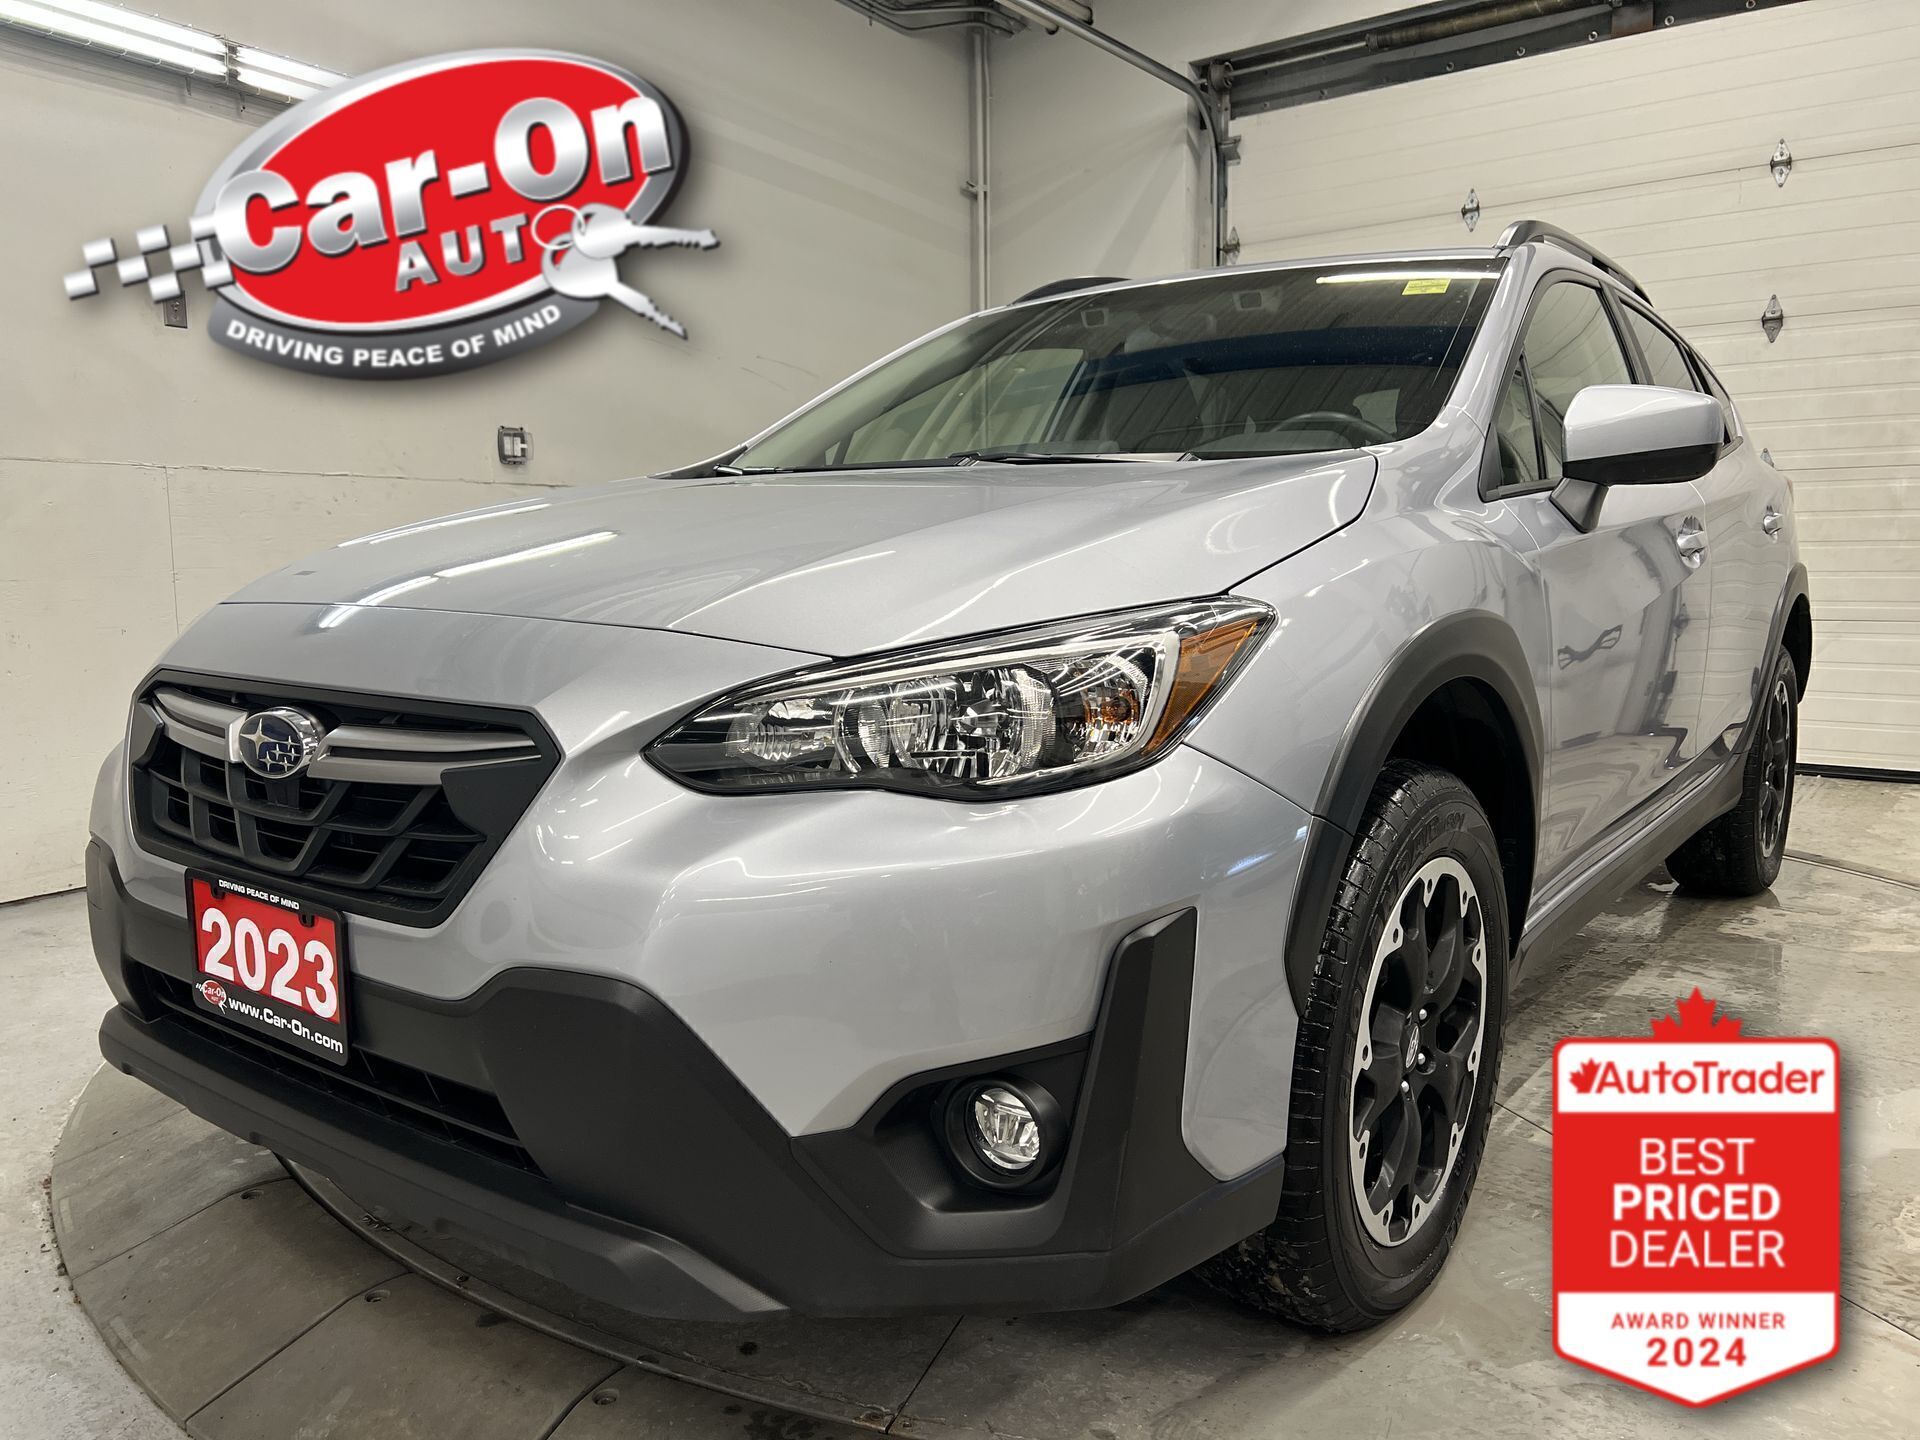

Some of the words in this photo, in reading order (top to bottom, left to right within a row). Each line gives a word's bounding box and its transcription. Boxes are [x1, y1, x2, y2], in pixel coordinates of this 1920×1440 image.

[218, 879, 246, 894] DRIVING
[246, 887, 269, 901] PEACE
[269, 894, 280, 904] OF
[280, 897, 300, 910] MIND
[201, 907, 338, 1018] 2023
[228, 997, 344, 1054] www.Car-On.com
